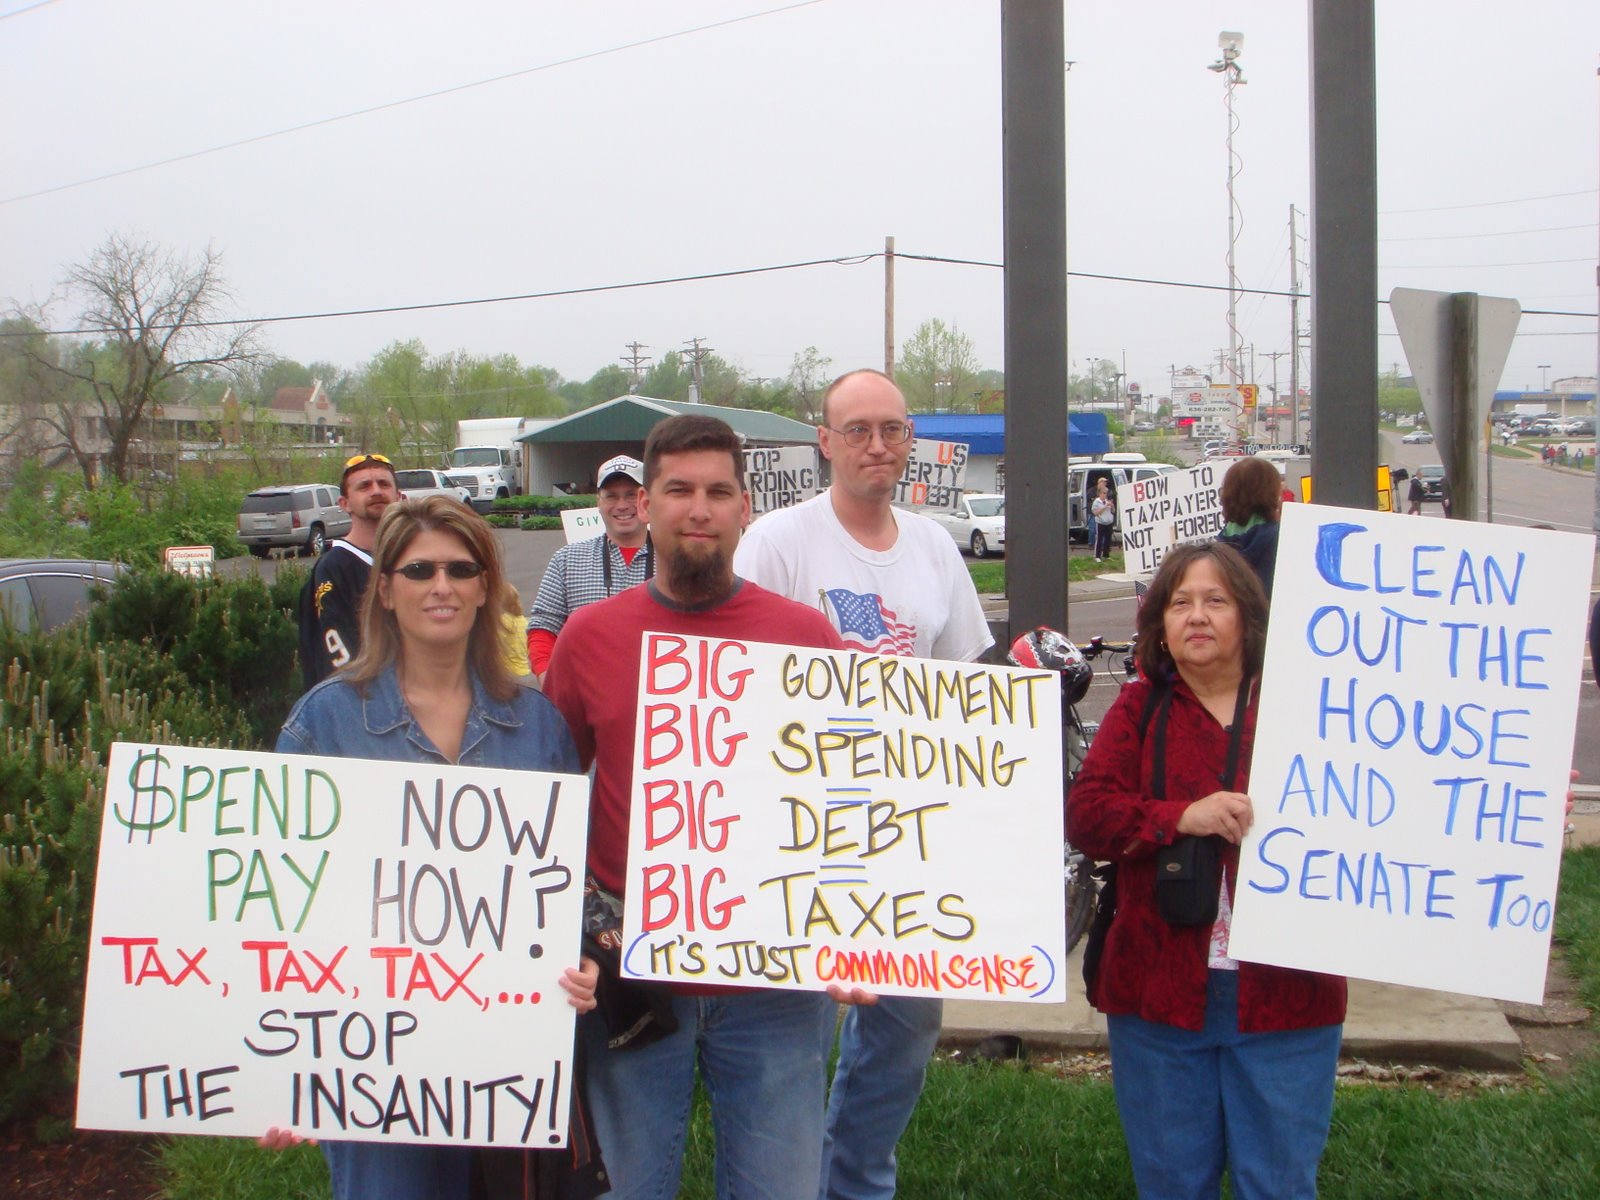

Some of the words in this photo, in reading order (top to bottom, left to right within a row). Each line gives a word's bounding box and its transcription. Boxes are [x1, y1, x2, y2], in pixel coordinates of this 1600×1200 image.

[742, 450, 780, 471] TOP
[750, 468, 814, 492] RDING
[904, 460, 962, 487] ERTY
[938, 442, 967, 466] US
[1133, 476, 1168, 503] BOW
[1189, 466, 1213, 489] TO
[576, 516, 599, 527] GIV
[1124, 527, 1154, 551] NOT
[1315, 522, 1526, 606] CLEAN
[325, 628, 350, 667] 9
[646, 635, 755, 702] BIG
[780, 652, 1054, 729] GOVERNMENT
[1306, 605, 1428, 673] OUT
[1439, 622, 1553, 691] THE
[643, 703, 749, 770] BIG
[770, 721, 1029, 788] SPENDING
[1317, 677, 1532, 769] HOUSE
[642, 779, 741, 853] BIG
[778, 796, 950, 862] DEBT
[1278, 753, 1396, 827] AND
[1432, 776, 1548, 849] THE
[208, 848, 330, 933] PAY
[371, 857, 572, 959] HOW?
[641, 863, 747, 933] BIG
[758, 871, 977, 941] TAXES
[1248, 826, 1456, 919] SENATE
[101, 936, 230, 998] TAX,
[241, 940, 360, 1000] TAX,
[715, 940, 812, 985] JUST
[243, 1008, 418, 1066] STOP
[119, 1064, 240, 1121] THE
[291, 1060, 562, 1145] INSANITY!
